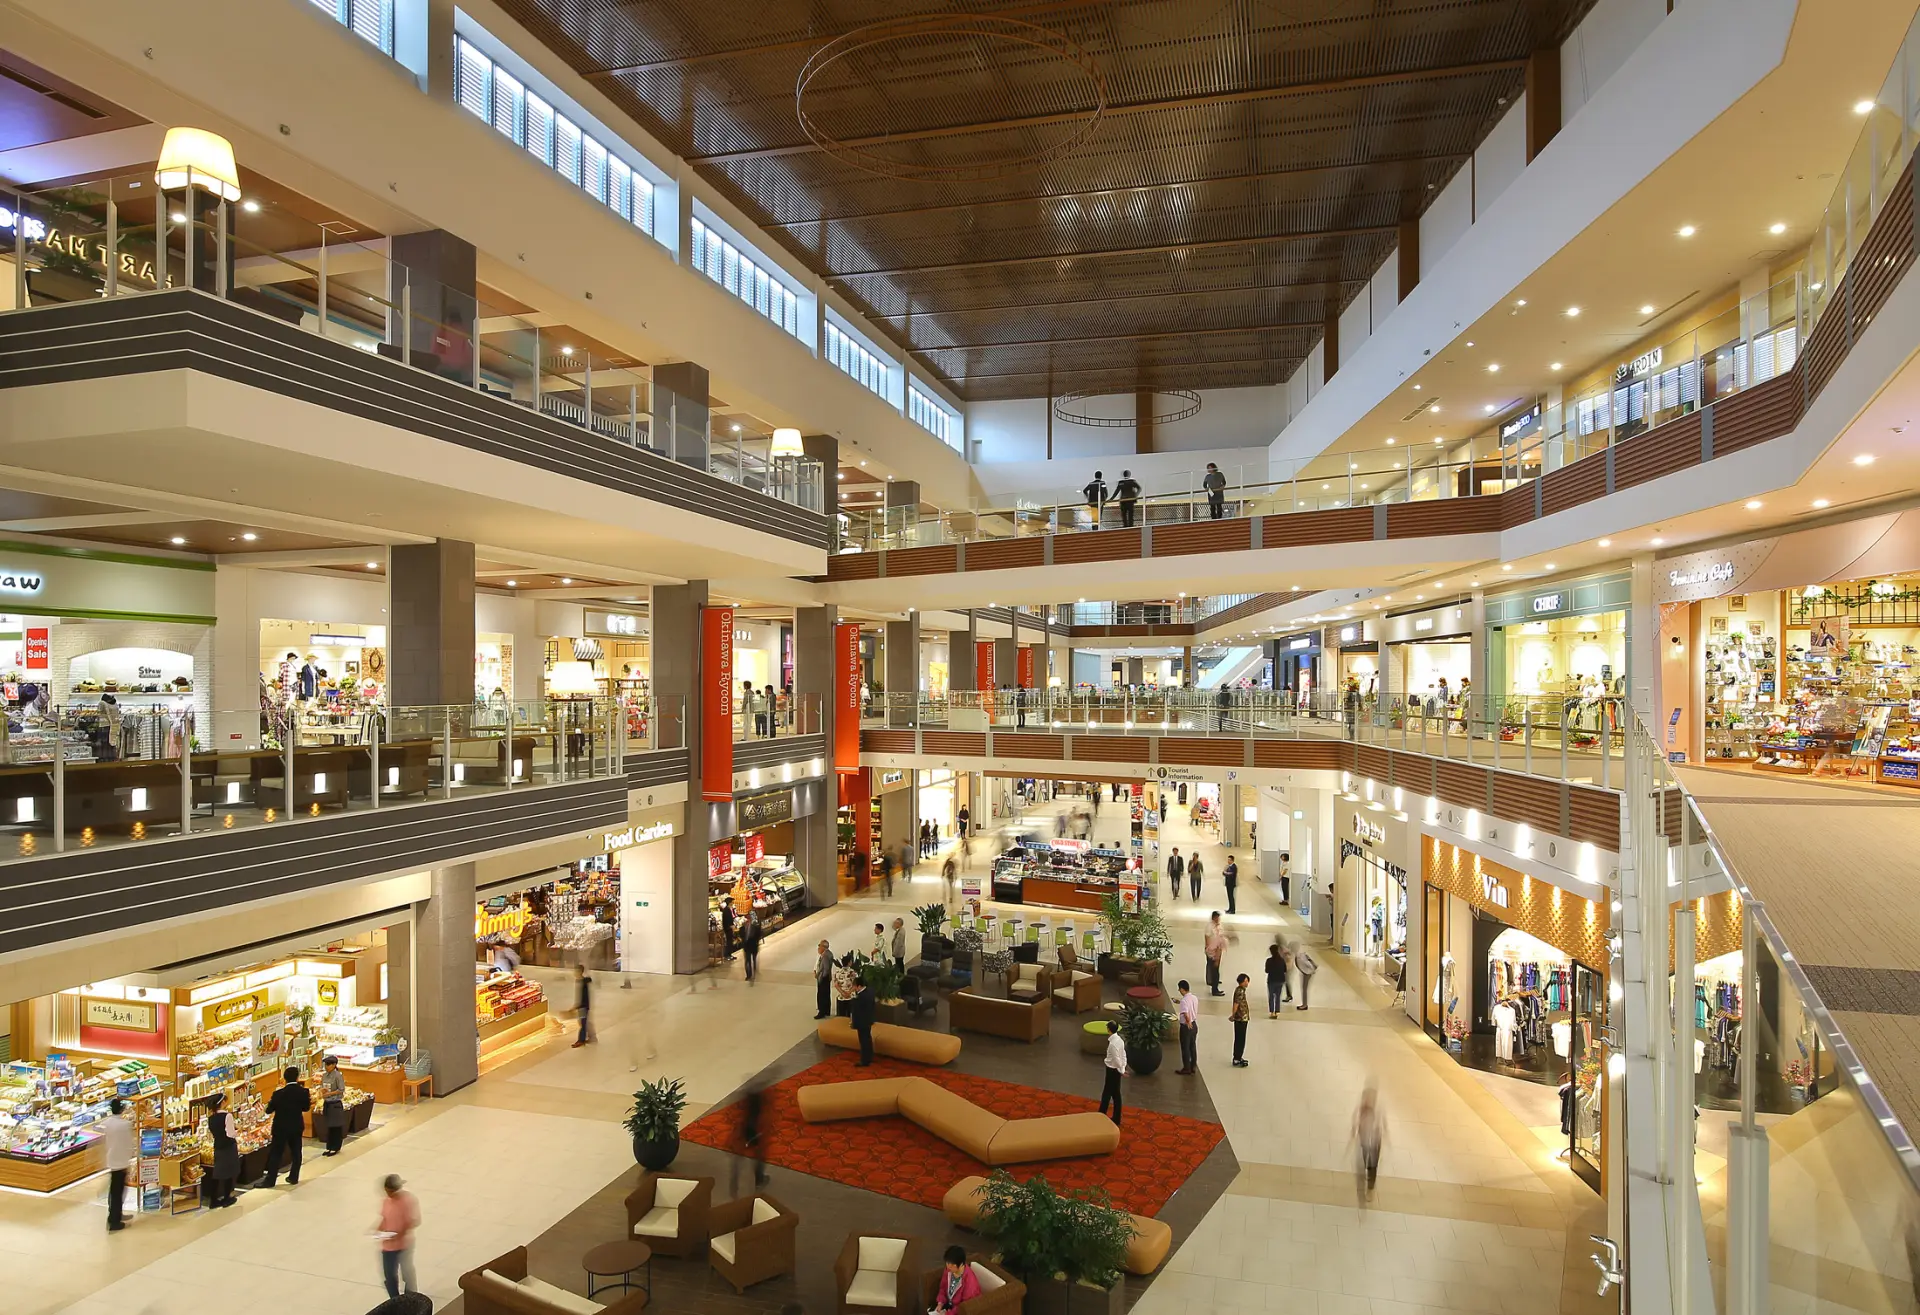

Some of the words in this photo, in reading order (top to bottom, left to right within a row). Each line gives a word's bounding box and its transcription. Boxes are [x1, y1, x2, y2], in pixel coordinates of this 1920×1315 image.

[1628, 348, 1659, 376] ARDIN
[0, 575, 41, 590] aw
[27, 637, 47, 648] Opening
[27, 650, 47, 658] Sale
[720, 612, 731, 669] Okinawa
[849, 627, 858, 671] Okinawa
[138, 666, 161, 675] Straw
[718, 671, 731, 716] Rycom
[848, 673, 858, 708] Rycom
[603, 827, 633, 850] Food
[634, 821, 672, 842] Garden
[1481, 872, 1508, 908] Vin
